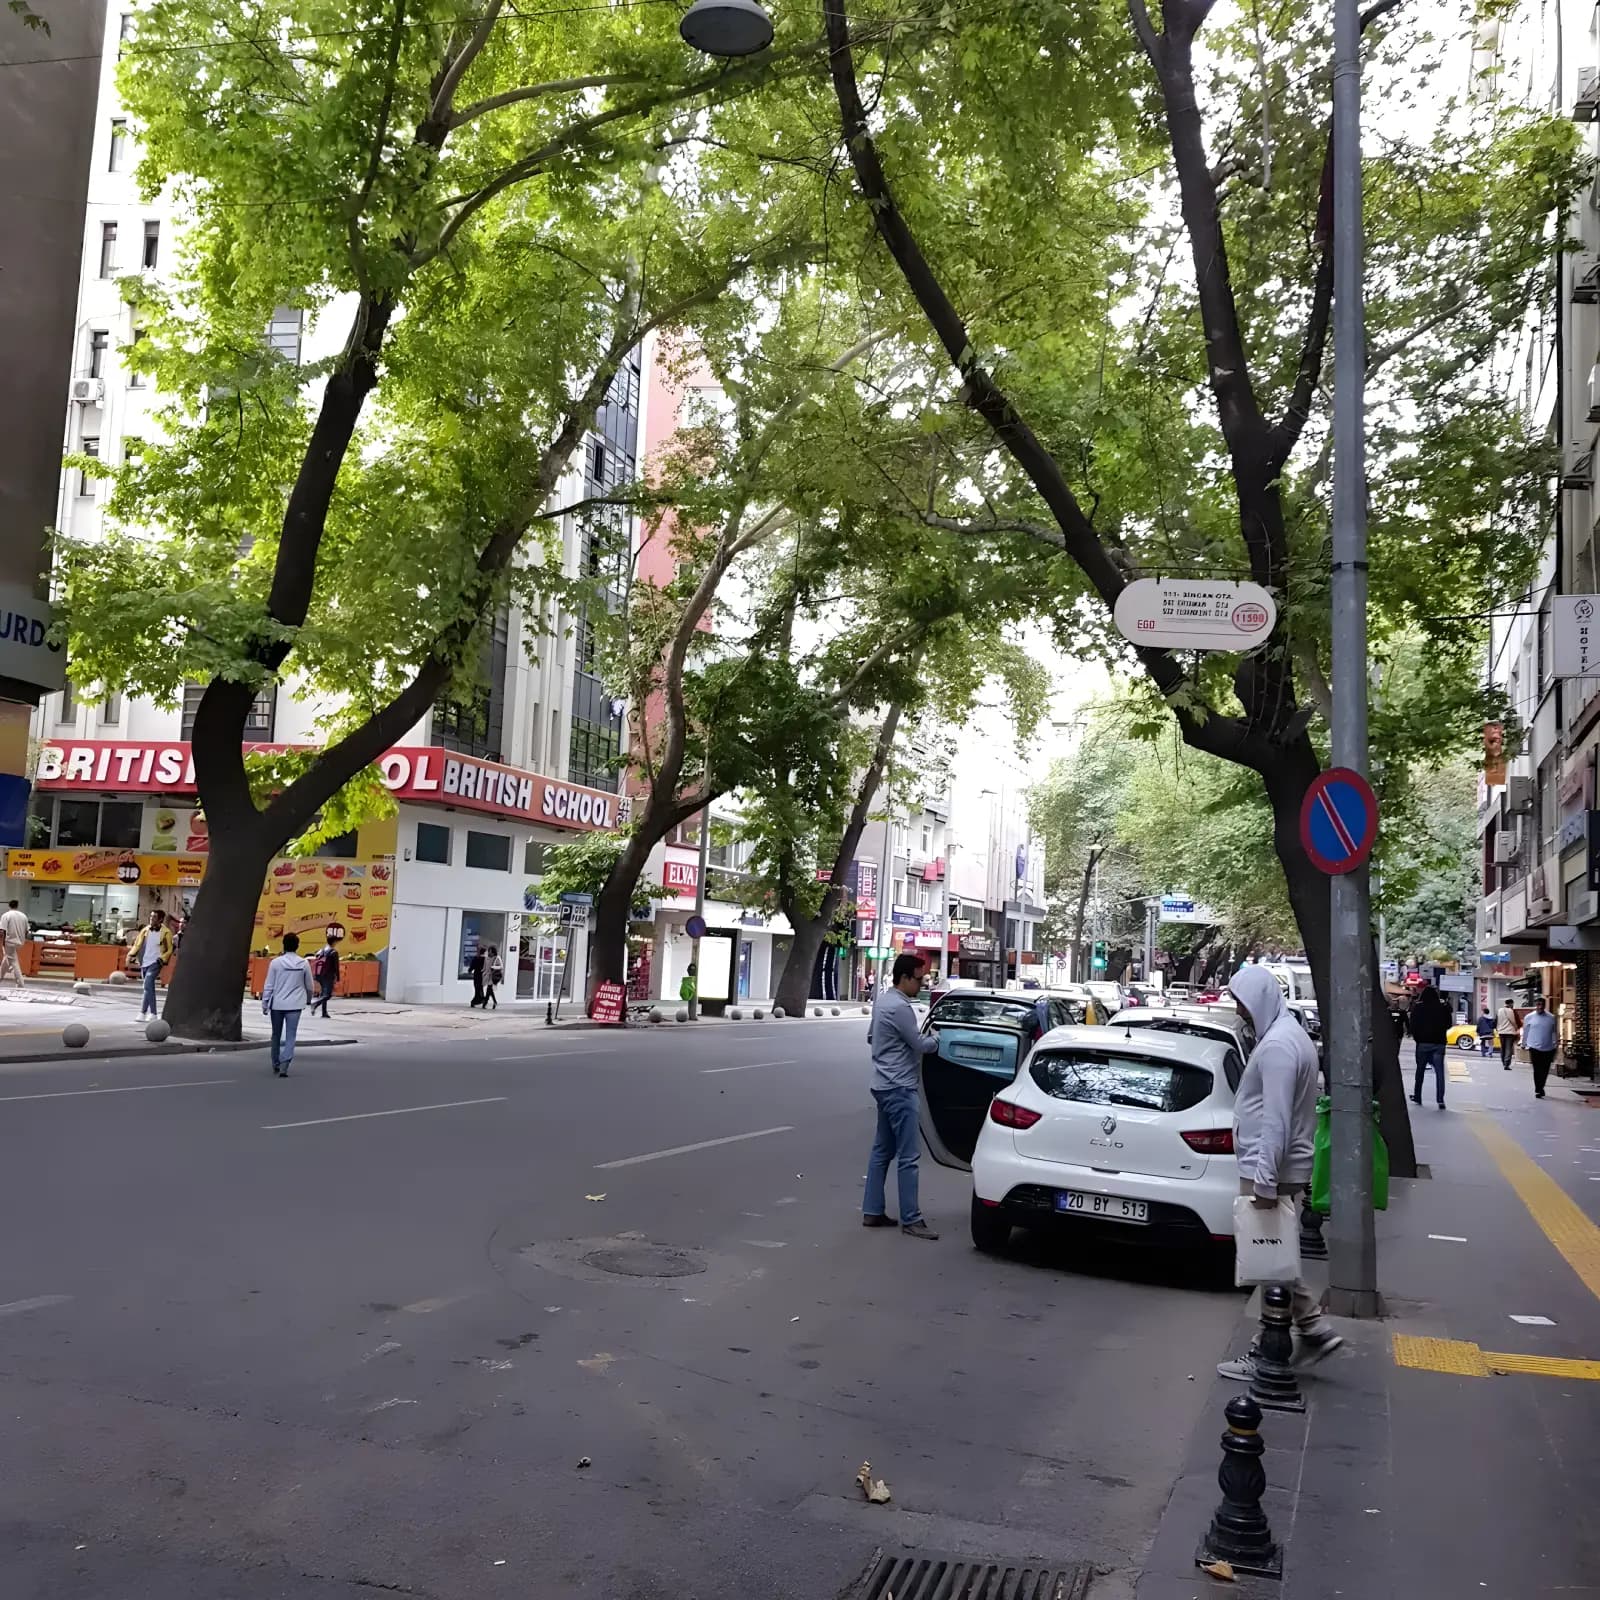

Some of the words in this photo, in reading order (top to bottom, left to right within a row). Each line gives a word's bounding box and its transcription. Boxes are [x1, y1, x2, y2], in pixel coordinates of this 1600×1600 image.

[1137, 619, 1155, 630] EGO
[443, 759, 533, 811] BRITISH
[542, 783, 612, 828] SCHOOL
[1068, 1193, 1084, 1209] 20
[1093, 1196, 1109, 1212] BY
[1122, 1201, 1146, 1218] 513
